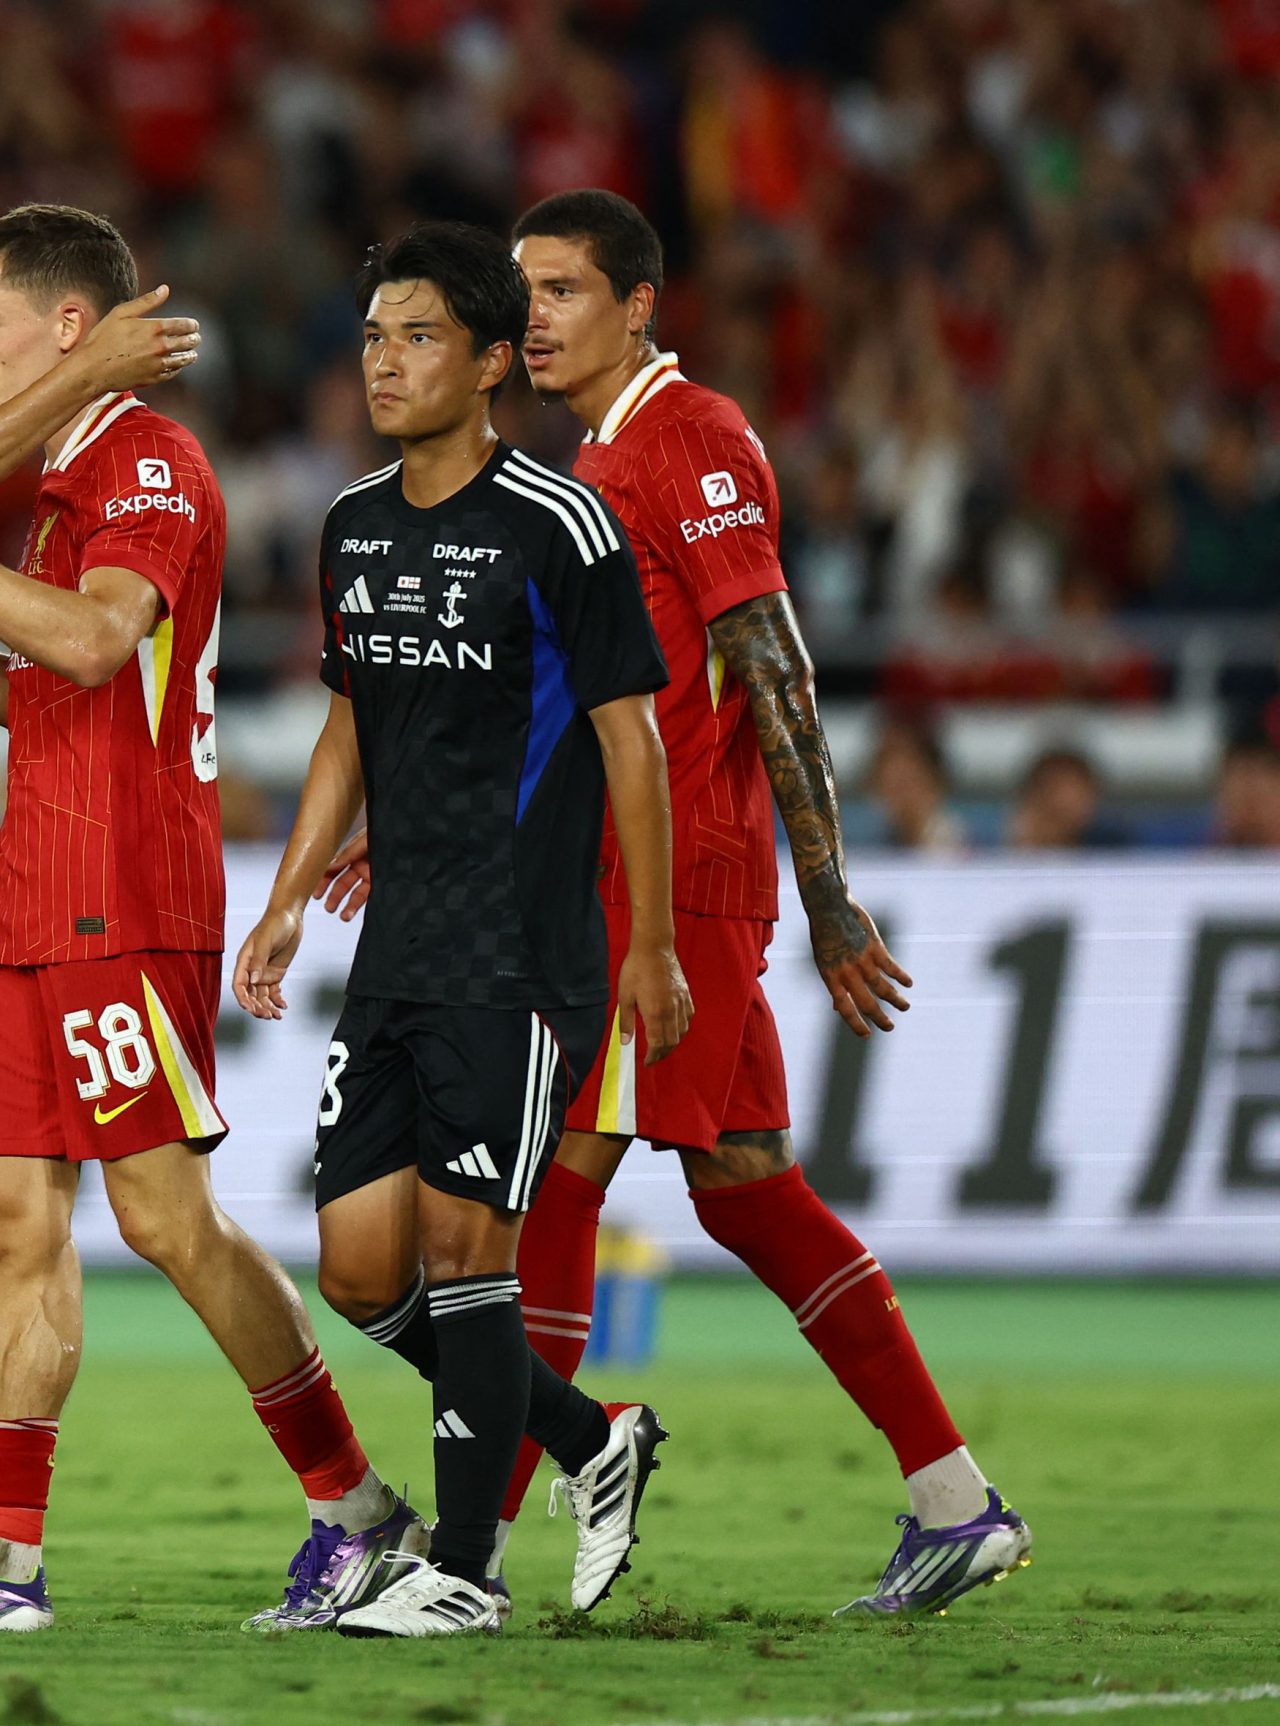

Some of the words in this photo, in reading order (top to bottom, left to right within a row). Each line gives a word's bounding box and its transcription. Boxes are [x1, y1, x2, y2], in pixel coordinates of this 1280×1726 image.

[340, 538, 393, 556] DRAFT
[432, 543, 502, 564] DRAFT
[62, 1001, 158, 1102] 58
